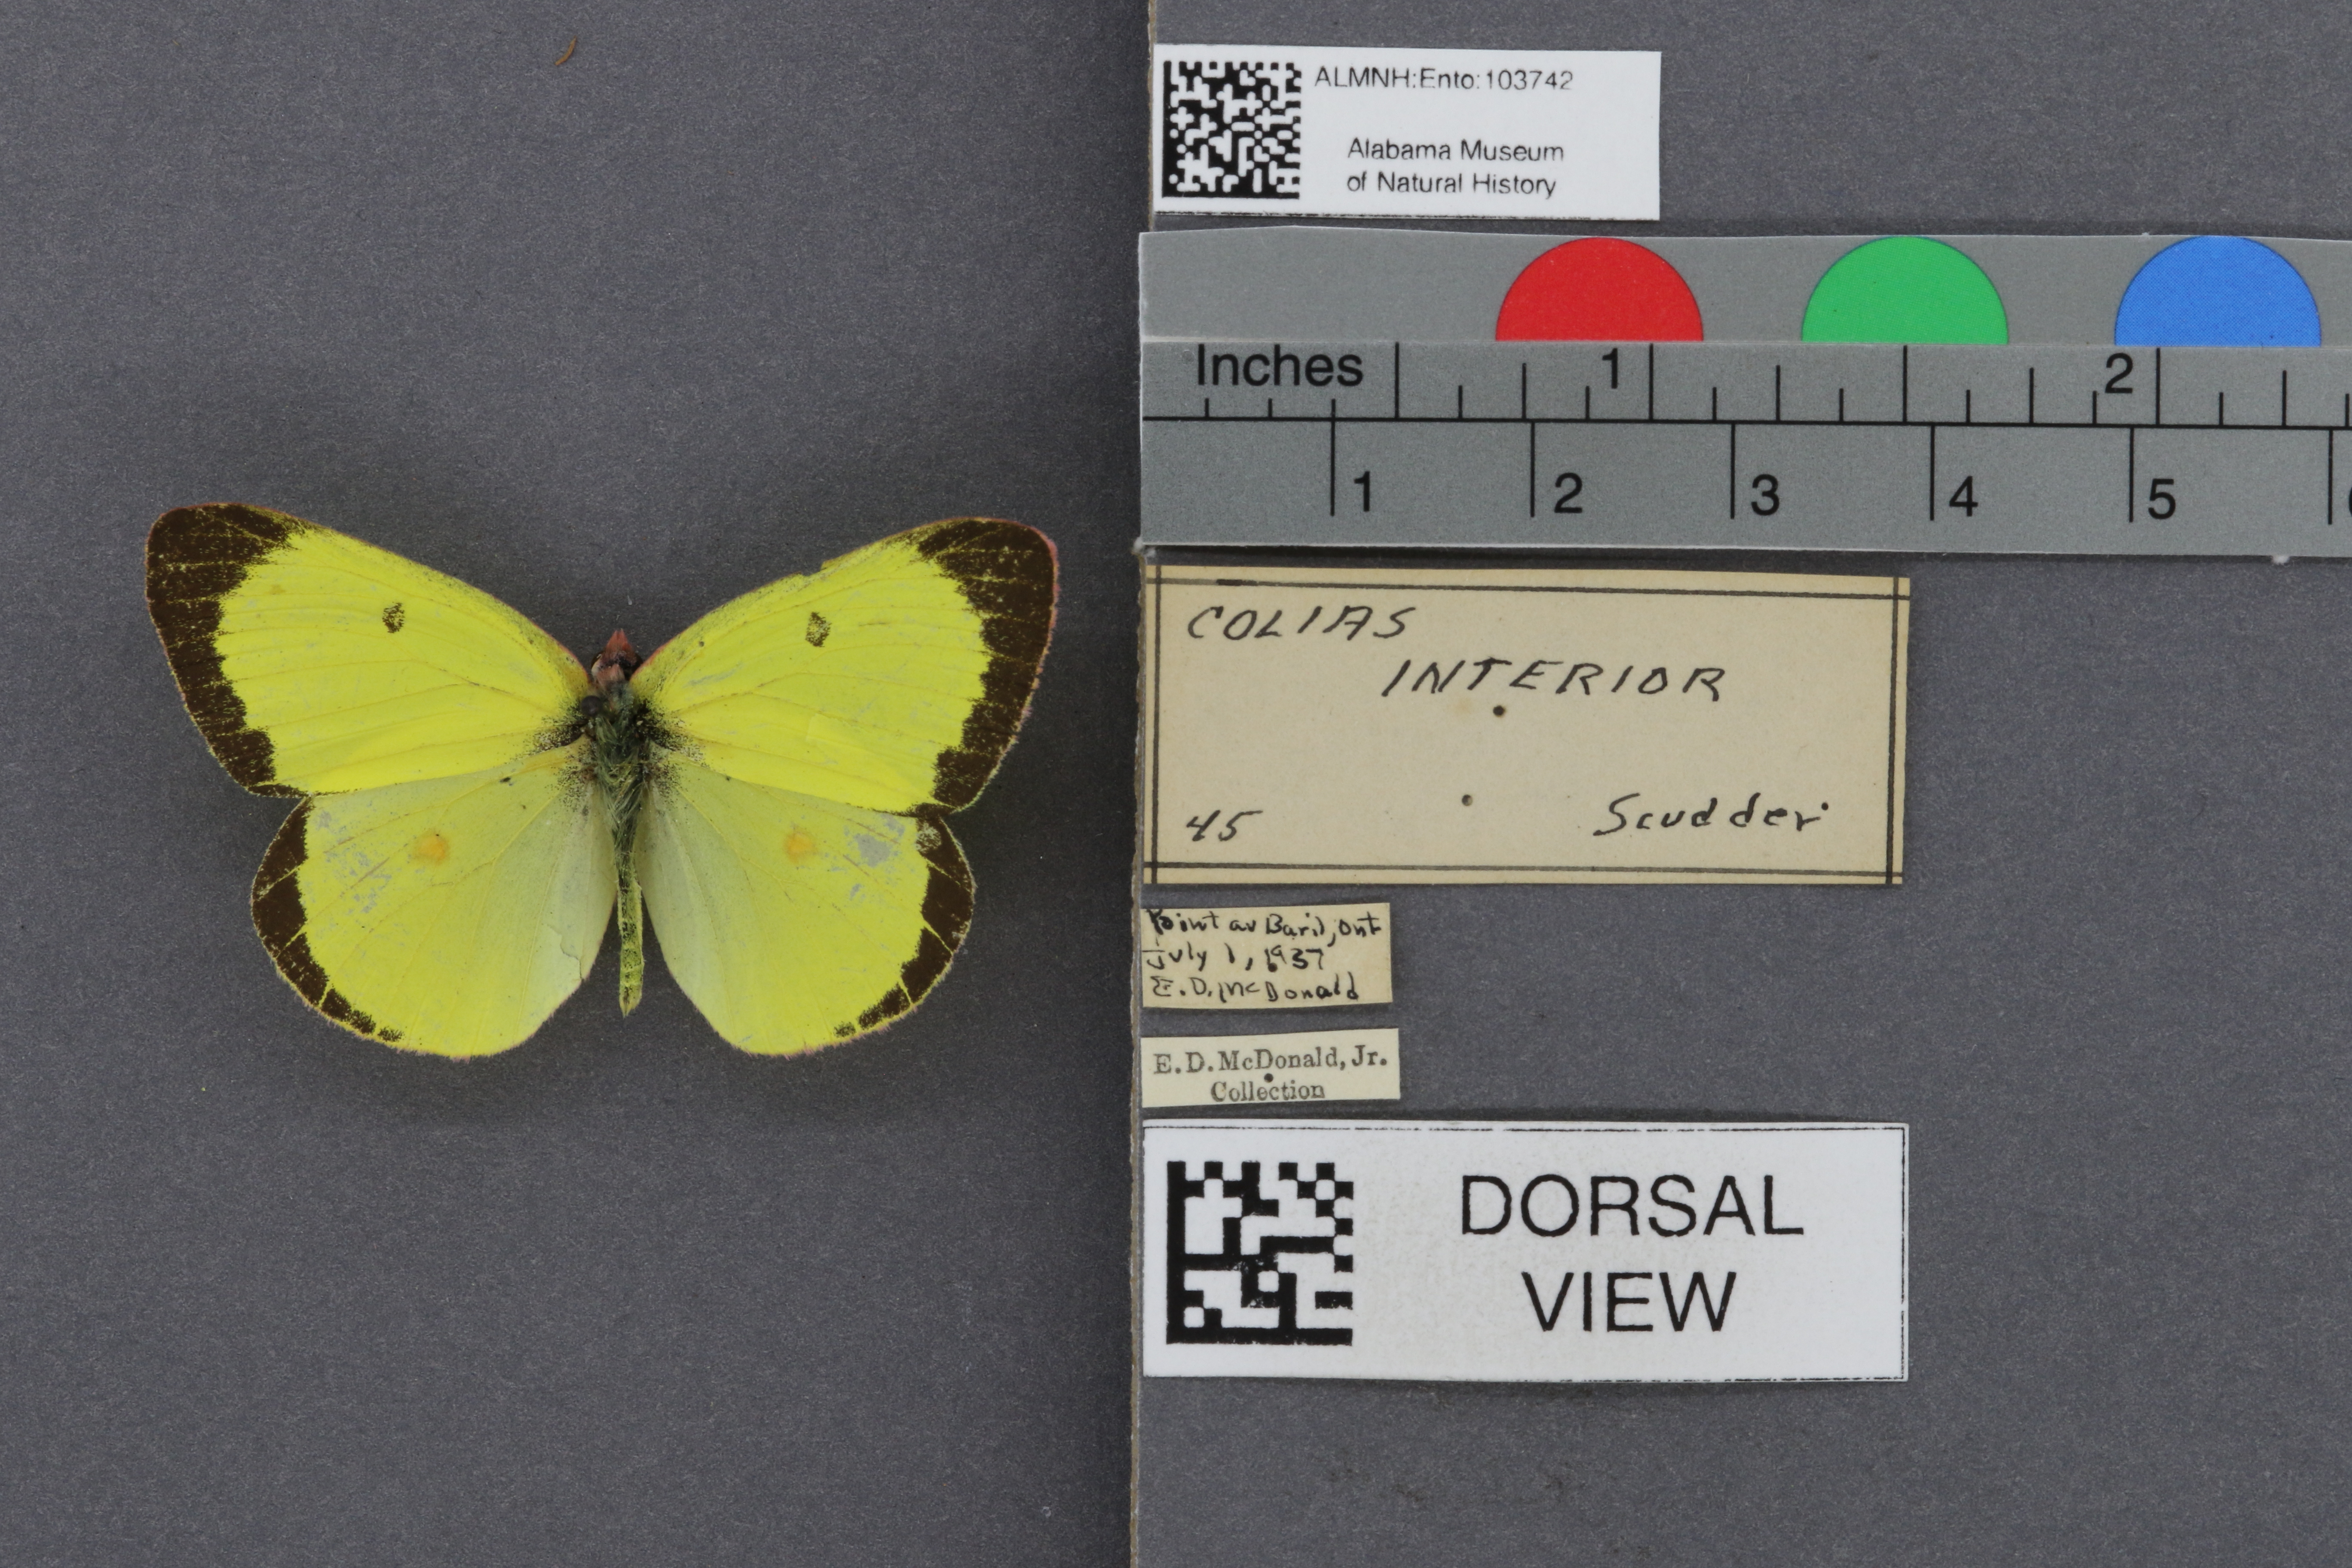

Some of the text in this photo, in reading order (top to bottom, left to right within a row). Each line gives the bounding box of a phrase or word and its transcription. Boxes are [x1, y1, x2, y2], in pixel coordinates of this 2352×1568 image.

[1315, 65, 1574, 90] ALMNH:Ento:103742
[1347, 137, 1565, 162] Alabama Museum
[1346, 172, 1558, 199] of Natural History
[1197, 344, 1364, 388] Inches
[1602, 347, 1618, 389] 1
[2104, 352, 2135, 395] 2
[1354, 470, 1370, 512] 1
[1553, 472, 1583, 514] 2
[1750, 473, 1780, 516] 3
[1948, 475, 1978, 518] 4
[2148, 478, 2177, 520] 5
[1187, 604, 1417, 641] COLIAS
[1381, 658, 1727, 702] INTERIOR
[1185, 809, 1263, 843] 45
[1211, 1080, 1326, 1102] Collection
[1461, 1175, 1804, 1237] DORSAL
[1522, 1271, 1737, 1332] VIEW
